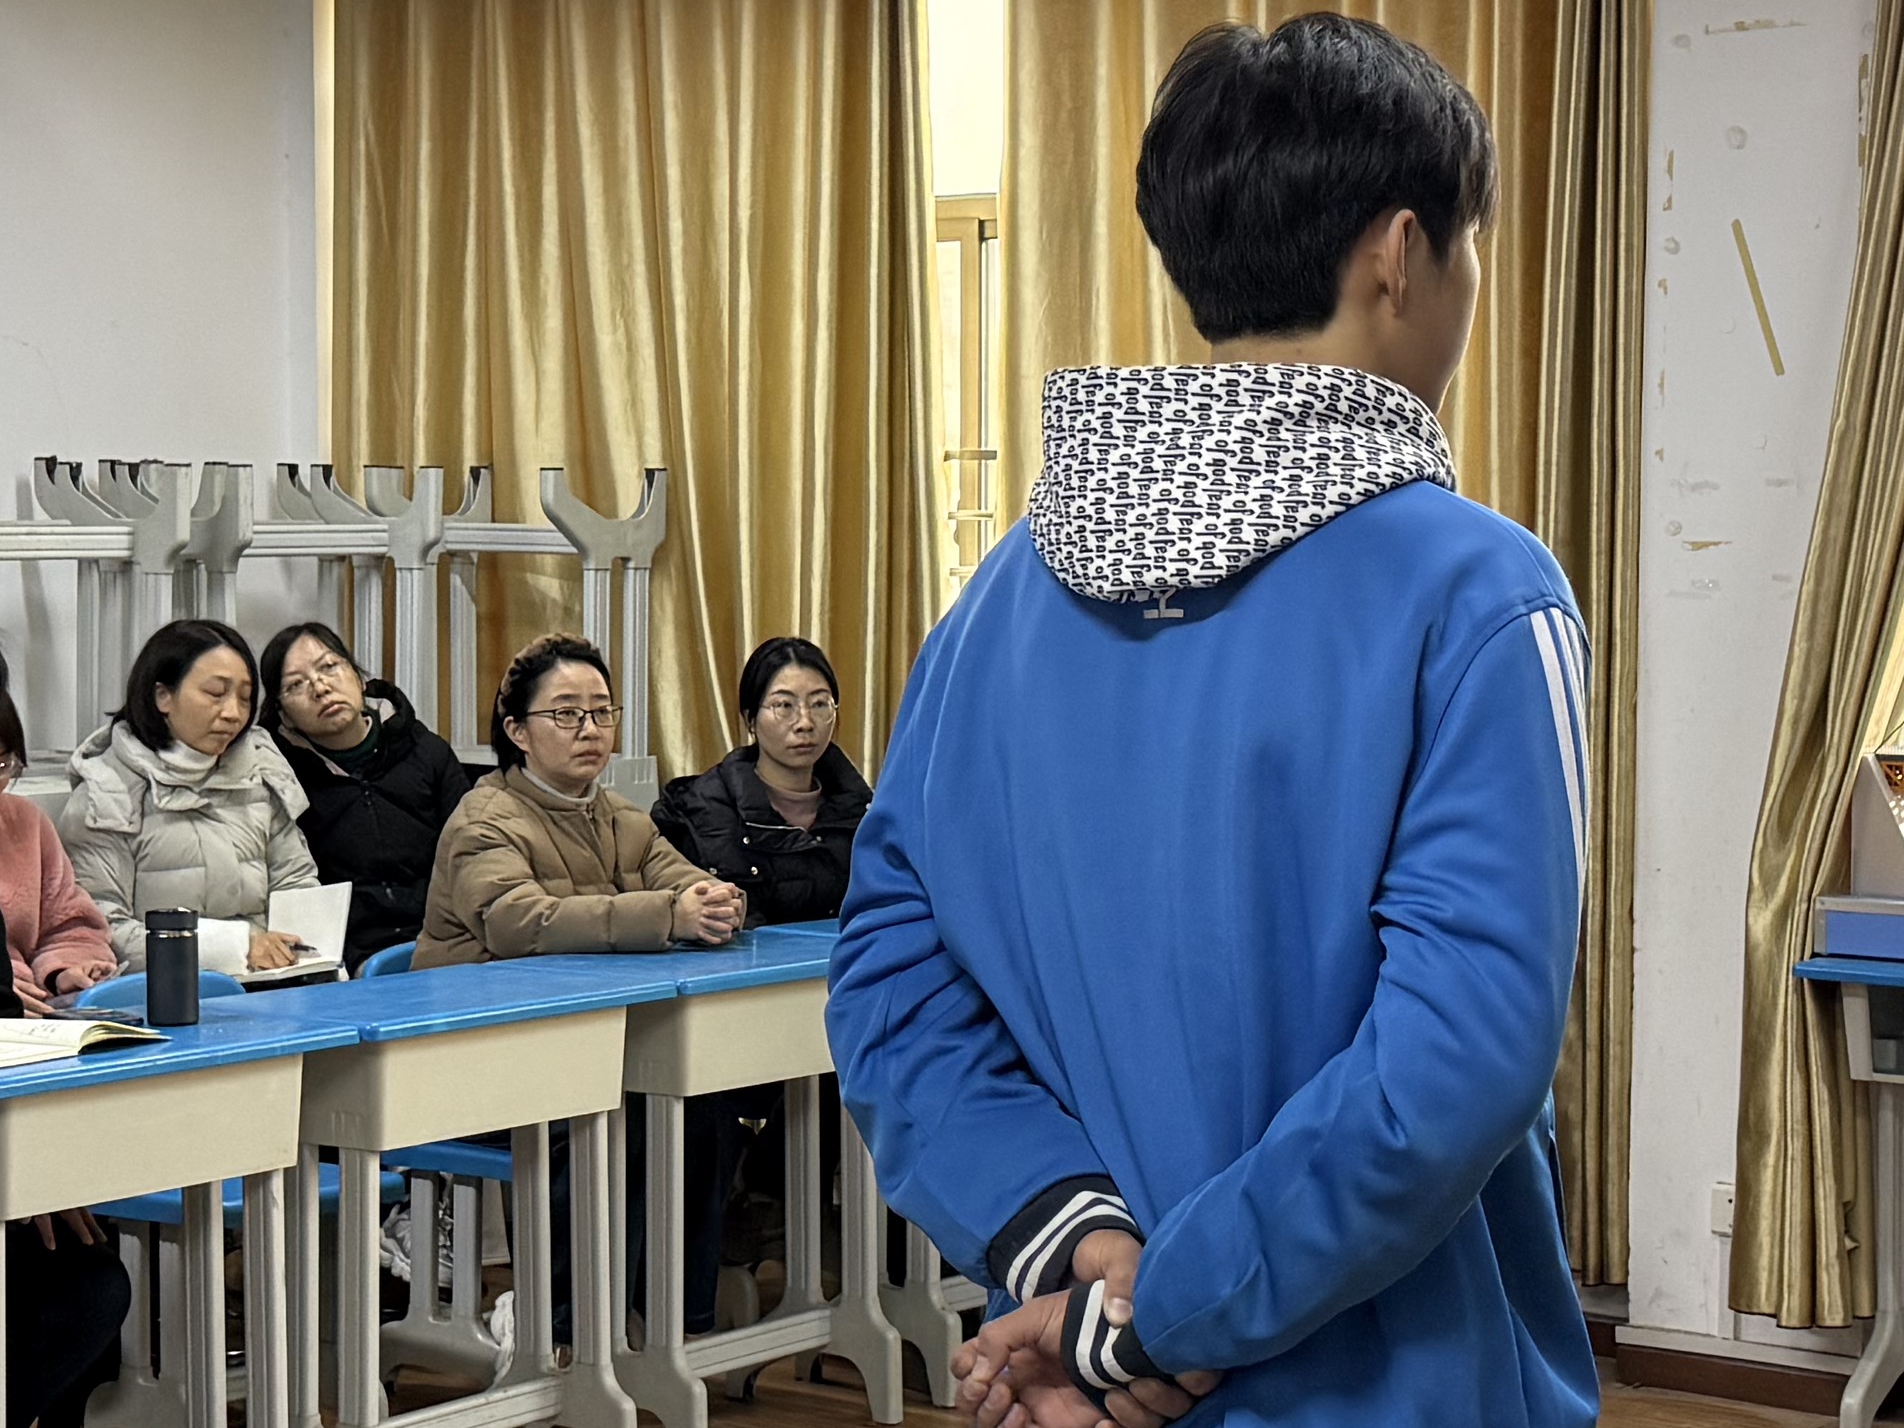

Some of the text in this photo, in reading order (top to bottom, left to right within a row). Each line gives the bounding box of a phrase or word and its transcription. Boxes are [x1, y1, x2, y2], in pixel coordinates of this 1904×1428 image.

[1120, 369, 1149, 386] of
[1324, 368, 1353, 387] of
[1097, 392, 1123, 410] of
[1190, 383, 1223, 402] of
[1295, 382, 1326, 404] of
[1164, 409, 1196, 427] of
[1266, 401, 1296, 420] of
[1076, 419, 1098, 436] of
[1234, 418, 1265, 438] of
[1138, 431, 1166, 446] of
[1309, 436, 1341, 454] of
[1061, 445, 1079, 461] of
[1205, 439, 1238, 458] of
[1111, 453, 1139, 470] of
[1281, 457, 1314, 474] of
[1178, 463, 1209, 481] of
[1090, 478, 1115, 495] of
[1253, 479, 1285, 494] of
[1152, 488, 1180, 506] of
[1072, 505, 1093, 522] of
[1223, 500, 1255, 516] of
[1128, 513, 1154, 530] of
[1195, 523, 1227, 540] of
[1108, 539, 1132, 556] of
[1168, 548, 1198, 566] of
[1219, 548, 1251, 573] fea
[1091, 566, 1110, 582] of
[1125, 564, 1152, 587] fea
